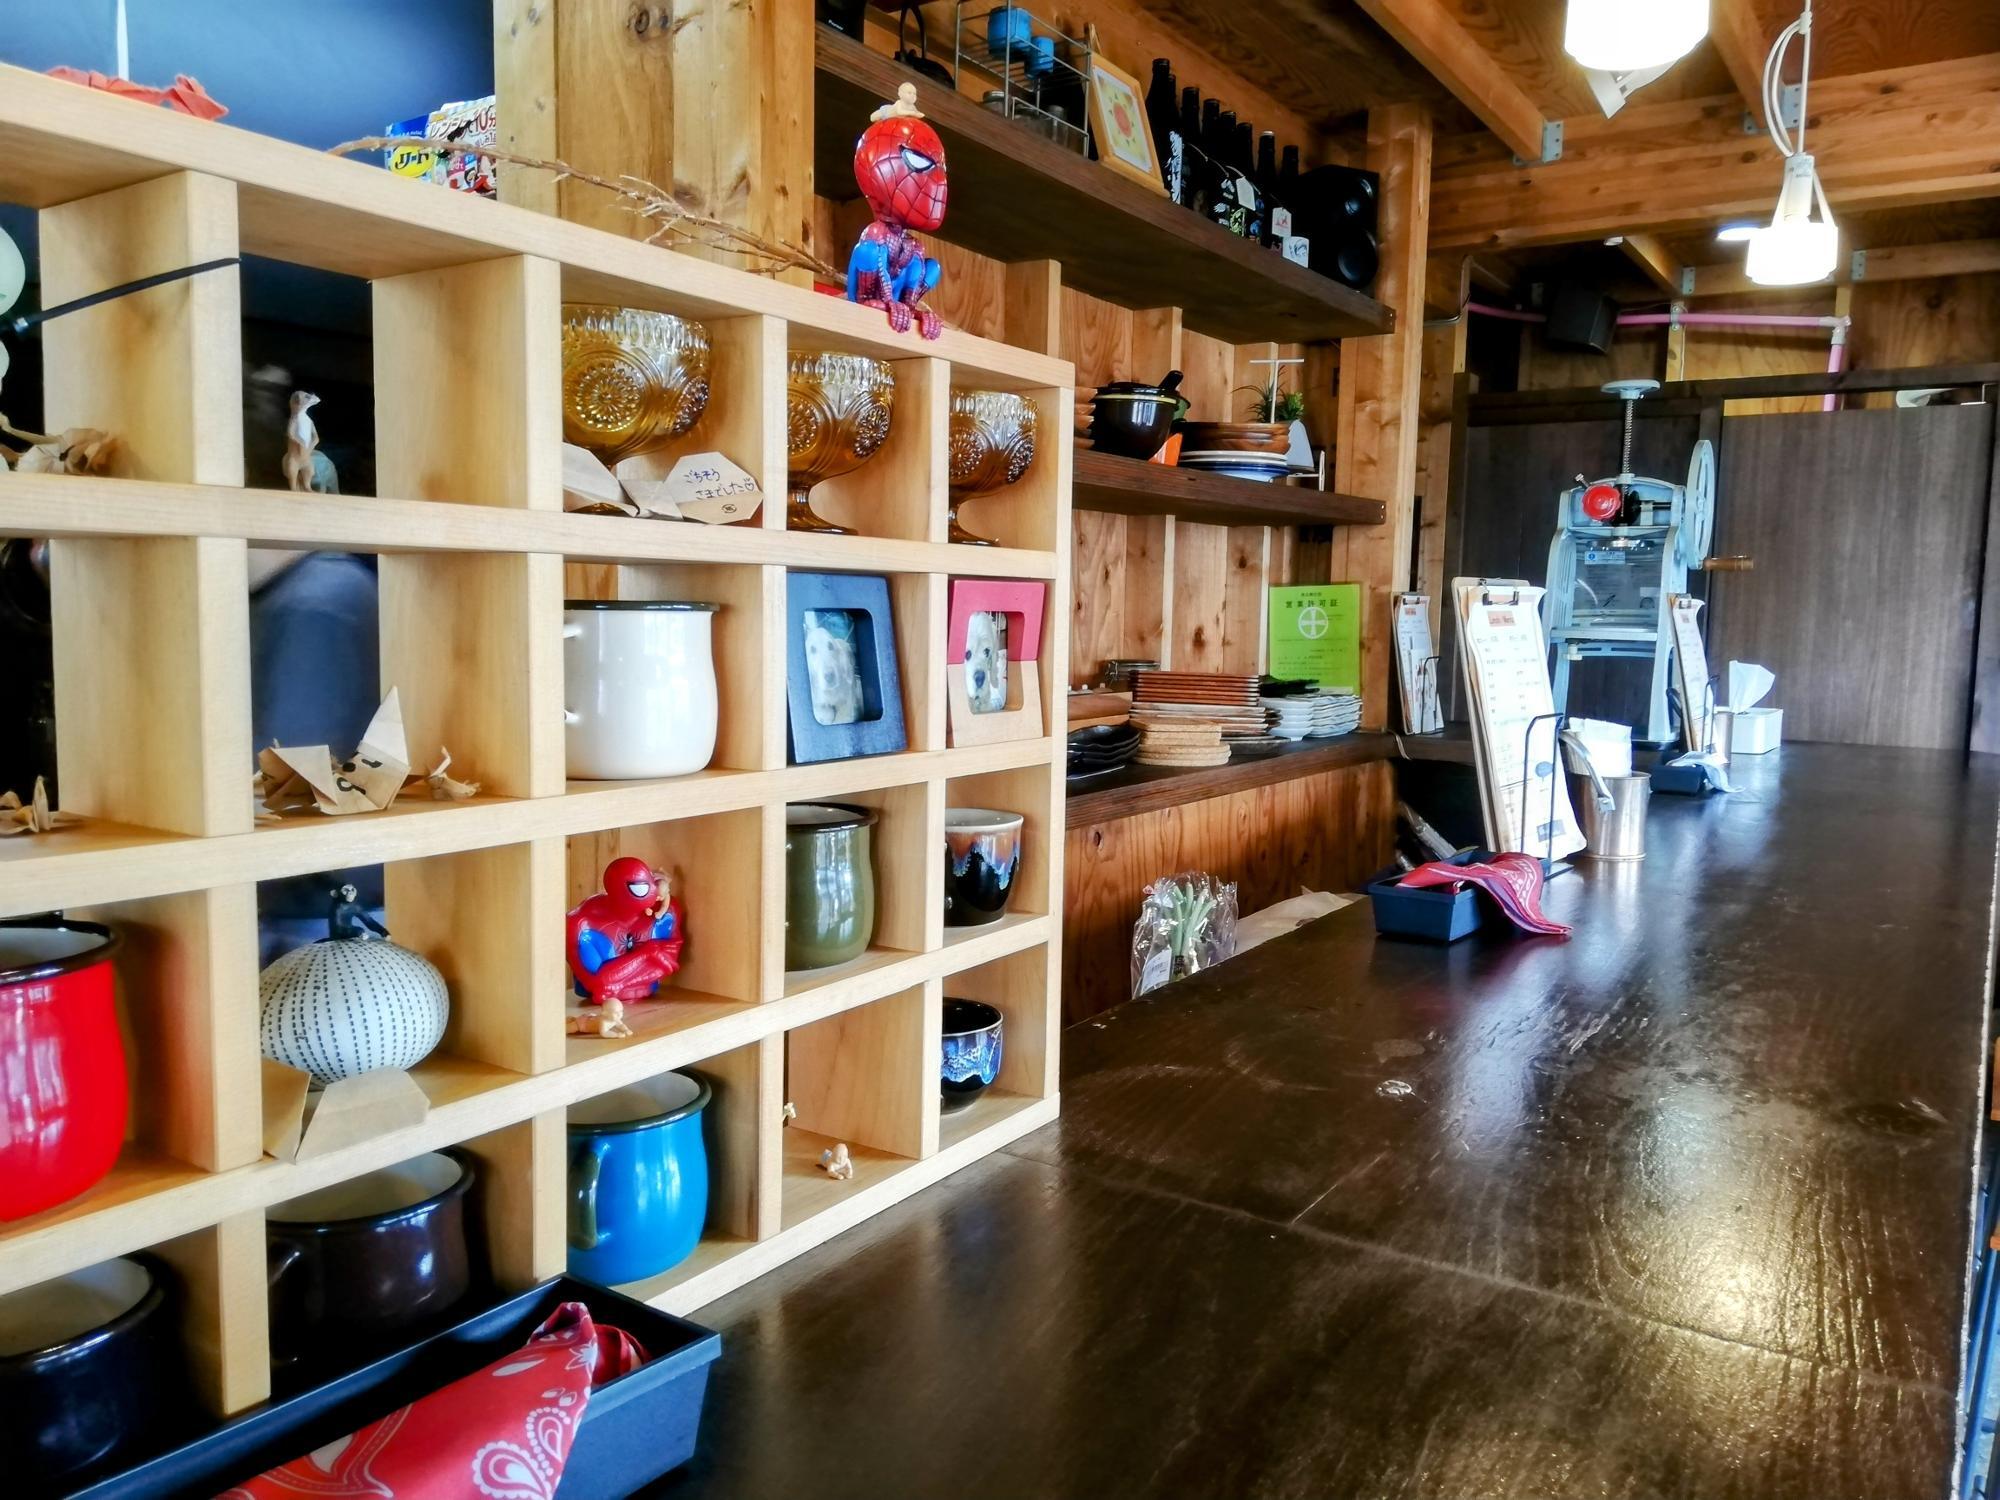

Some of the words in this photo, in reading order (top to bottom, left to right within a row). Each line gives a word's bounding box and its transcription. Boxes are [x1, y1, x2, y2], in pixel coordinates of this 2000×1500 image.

[684, 468, 720, 483] ごちそう
[695, 482, 745, 500] さまでした
